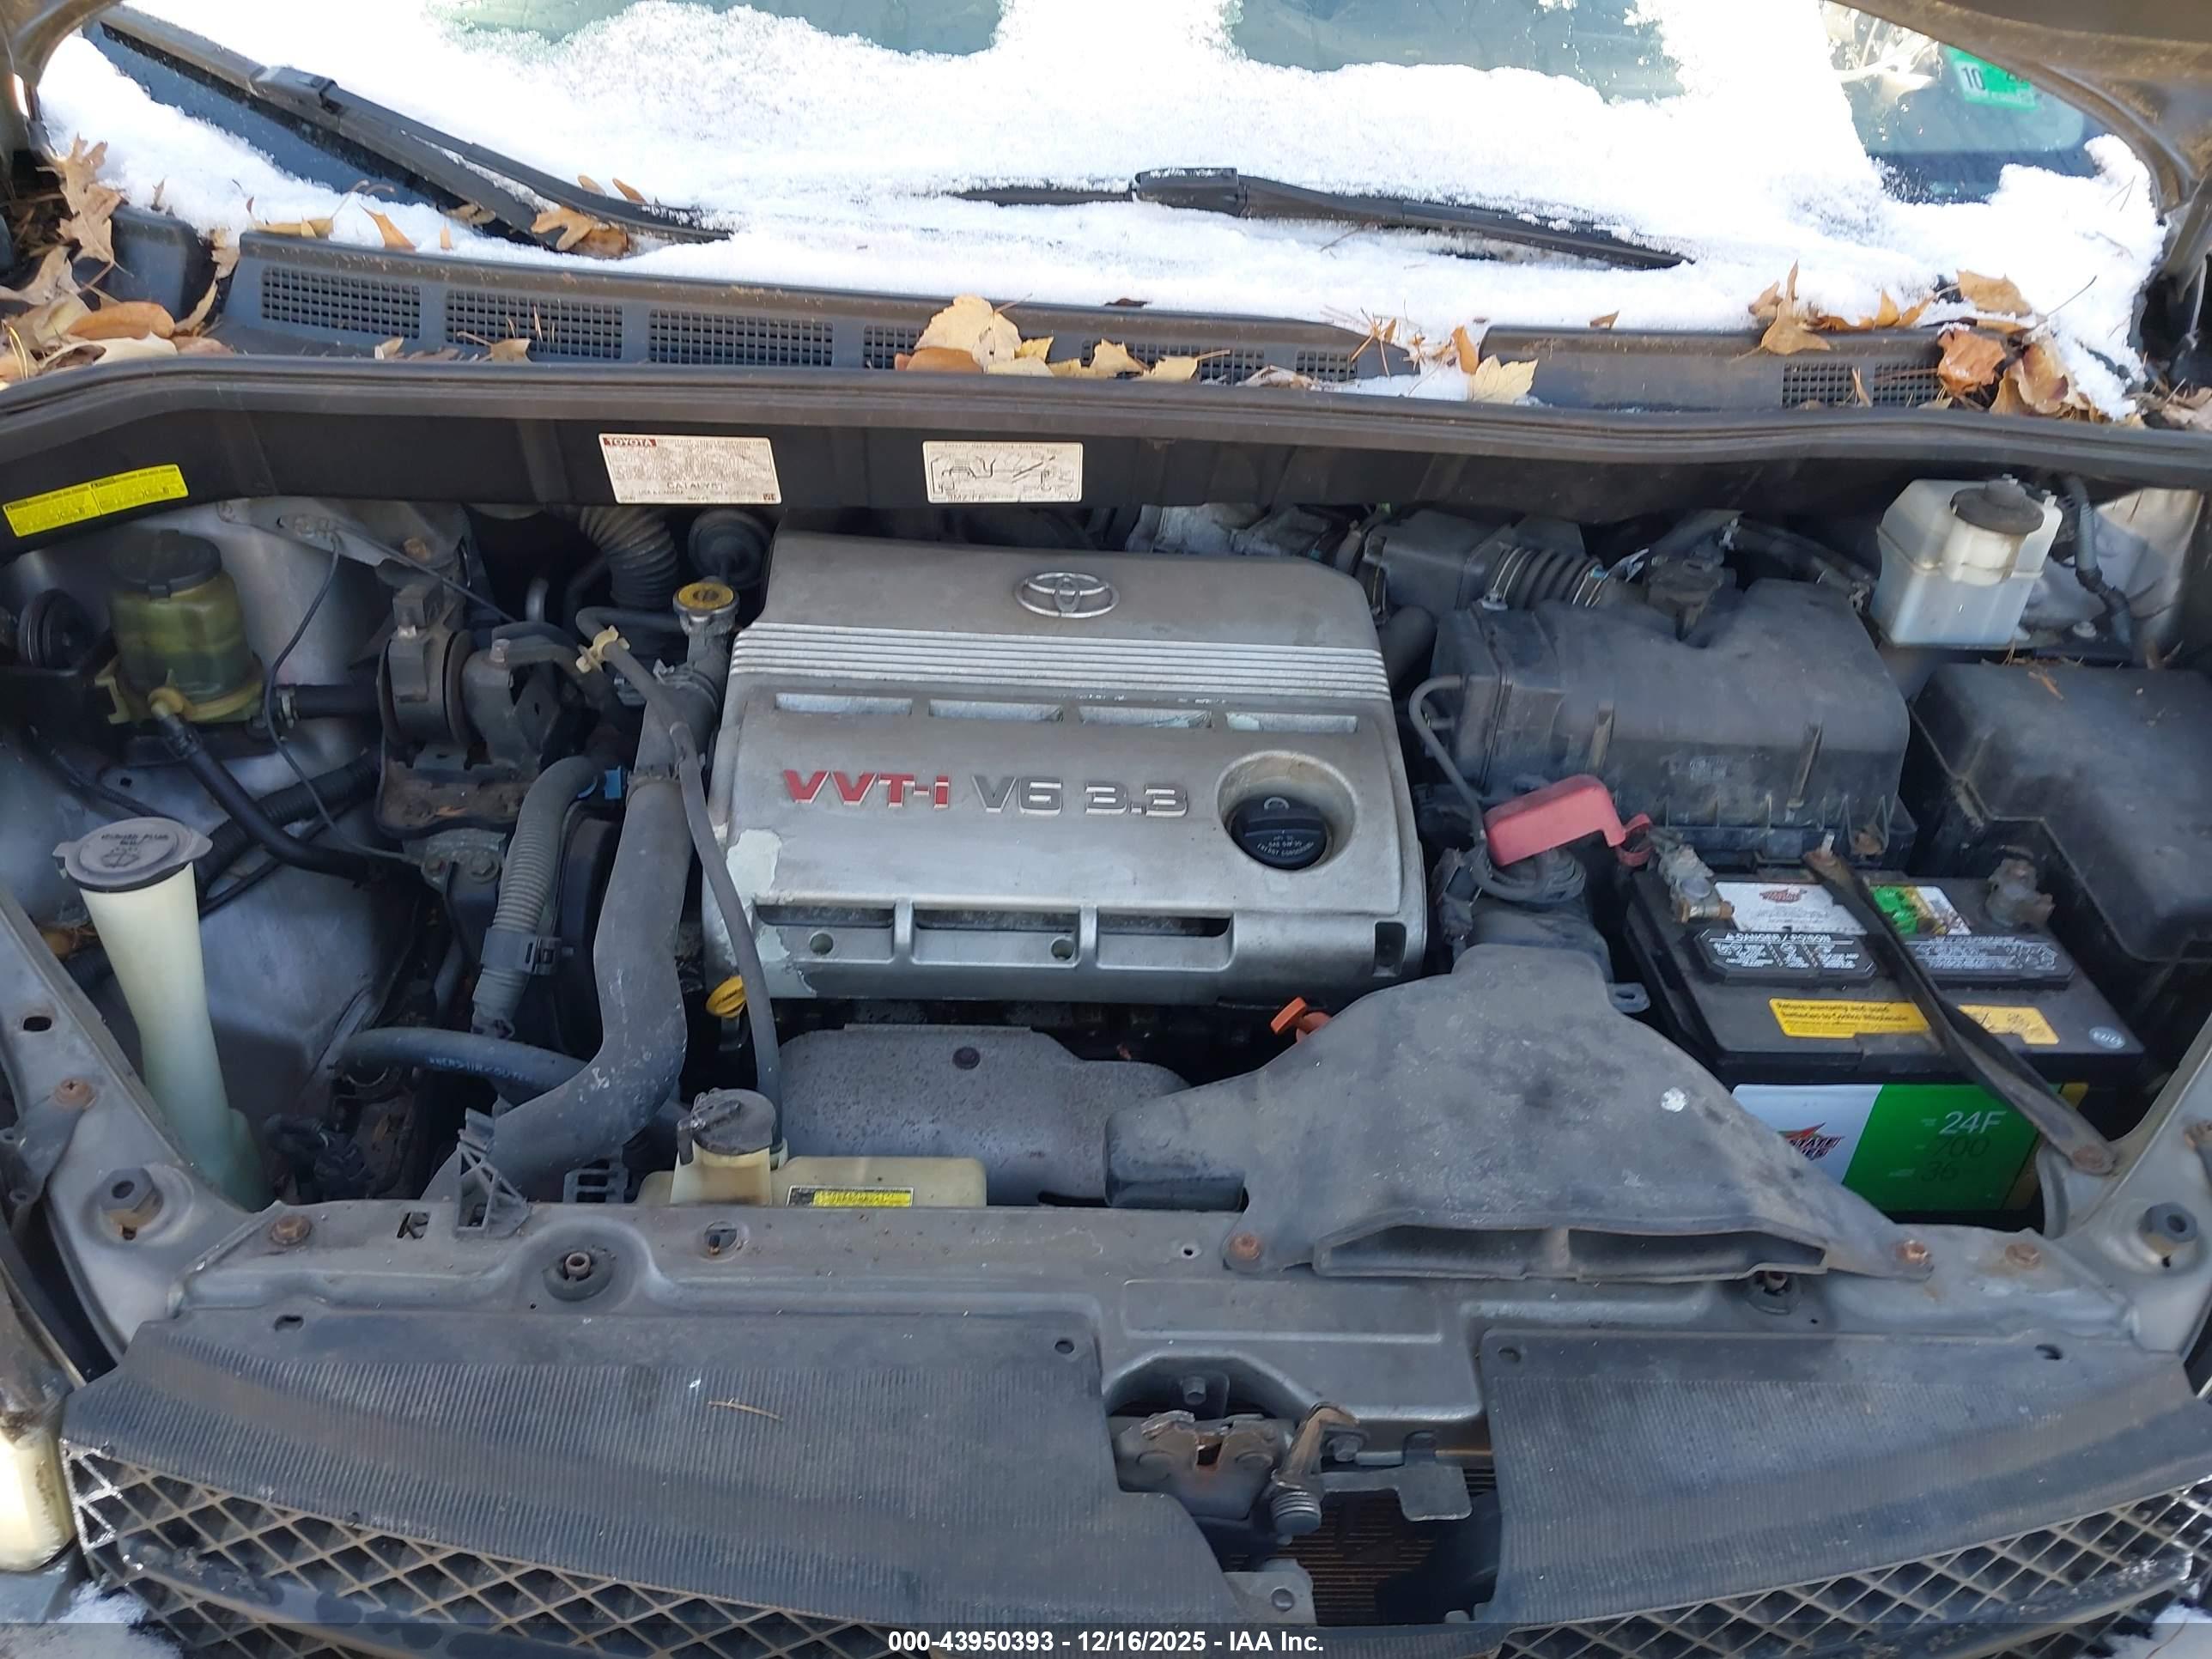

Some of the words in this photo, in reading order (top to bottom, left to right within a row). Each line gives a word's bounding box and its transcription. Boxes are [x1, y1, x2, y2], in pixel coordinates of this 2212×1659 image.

[1960, 66, 1986, 90] 10
[605, 438, 654, 447] TOYOTA
[783, 769, 951, 809] VVT-i
[972, 775, 1063, 817] V6
[1085, 782, 1188, 818] 3.3
[1938, 1110, 2008, 1135] 24F
[1931, 1135, 1990, 1158] 700
